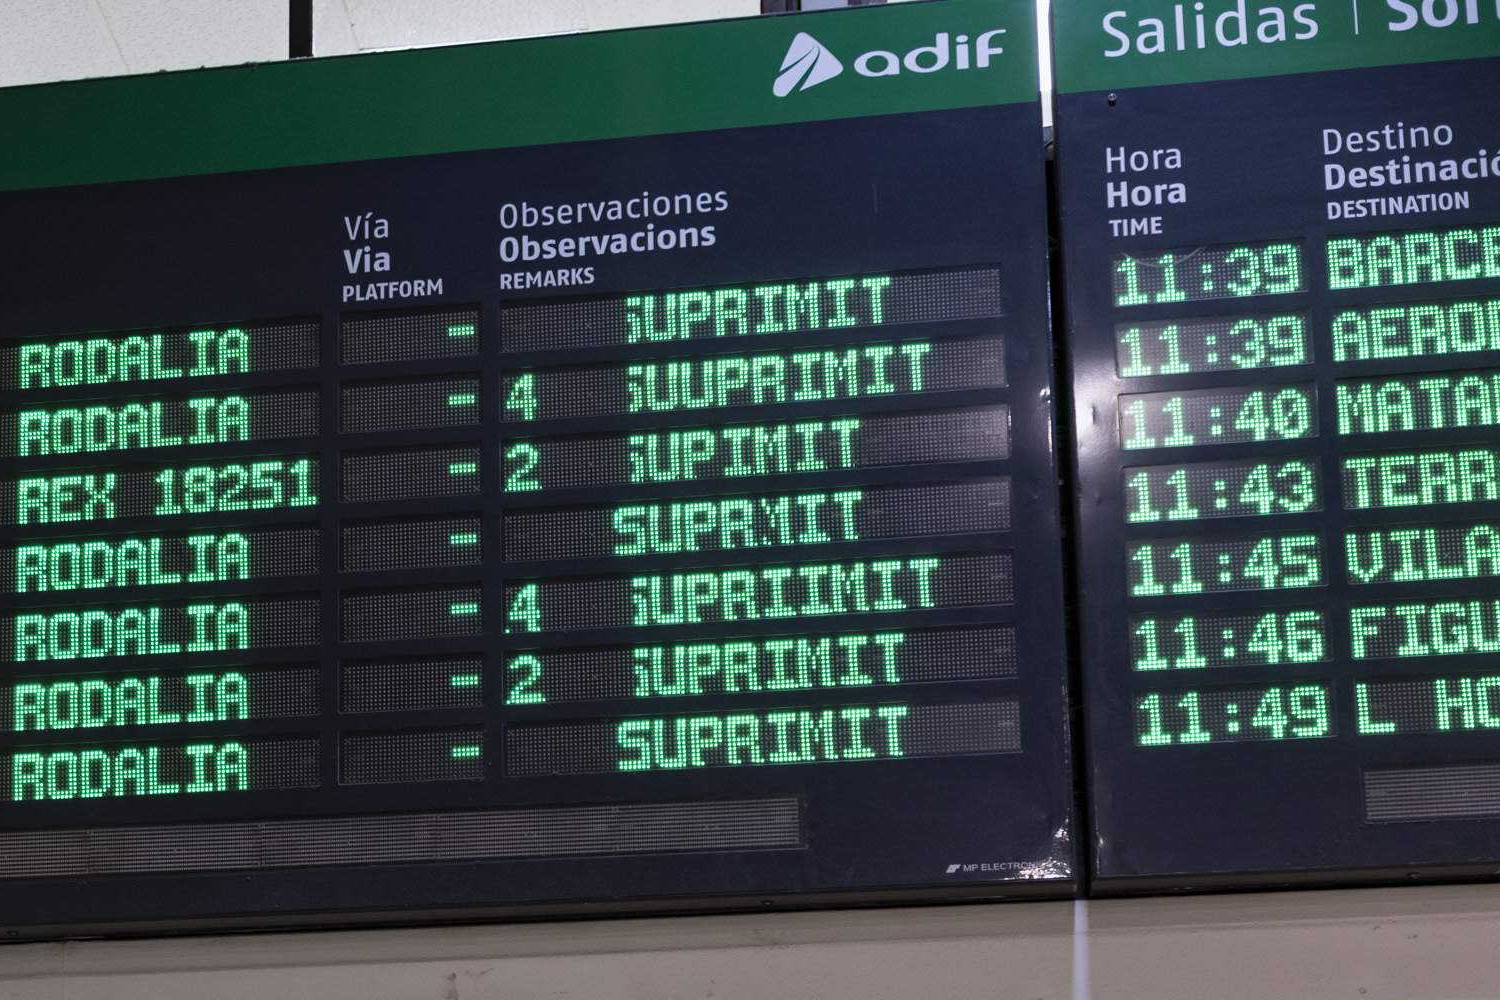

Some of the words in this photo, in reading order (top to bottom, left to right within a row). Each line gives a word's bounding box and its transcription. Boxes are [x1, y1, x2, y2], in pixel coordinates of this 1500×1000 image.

[854, 29, 1007, 77] adif
[1102, 0, 1318, 57] Salidas
[1386, 0, 1500, 31] Sor
[1106, 147, 1182, 174] Hora
[1323, 122, 1453, 155] Destino
[500, 190, 729, 229] Observaciones
[1106, 181, 1187, 208] Hora
[1327, 191, 1469, 220] DESTINATION
[344, 213, 389, 241] Vía
[500, 224, 716, 262] Observacions
[1109, 216, 1163, 237] TIME
[343, 247, 390, 274] Via
[500, 267, 595, 290] REMARKS
[1115, 244, 1300, 306] 11:39
[342, 278, 443, 302] PLATFORM
[19, 329, 248, 389] RODALIA
[1120, 316, 1305, 377] 11:39
[18, 396, 251, 456] RODALIA
[506, 374, 537, 421] 4
[1125, 388, 1310, 449] 11:40
[1337, 374, 1500, 434] MATA
[17, 473, 117, 524] REX
[154, 459, 317, 515] 18251
[505, 443, 541, 491] 2
[1129, 461, 1316, 522] 11:43
[15, 537, 250, 595] RODALIA
[1132, 535, 1320, 596] 11:45
[15, 603, 250, 661] RODALIA
[1135, 610, 1324, 671] 11:46
[13, 672, 250, 731] RODALIA
[506, 655, 546, 704] 2
[1139, 685, 1329, 746] 11:49
[1356, 684, 1395, 735] L
[12, 743, 247, 801] RODALIA
[616, 706, 909, 771] SUPRIMIT
